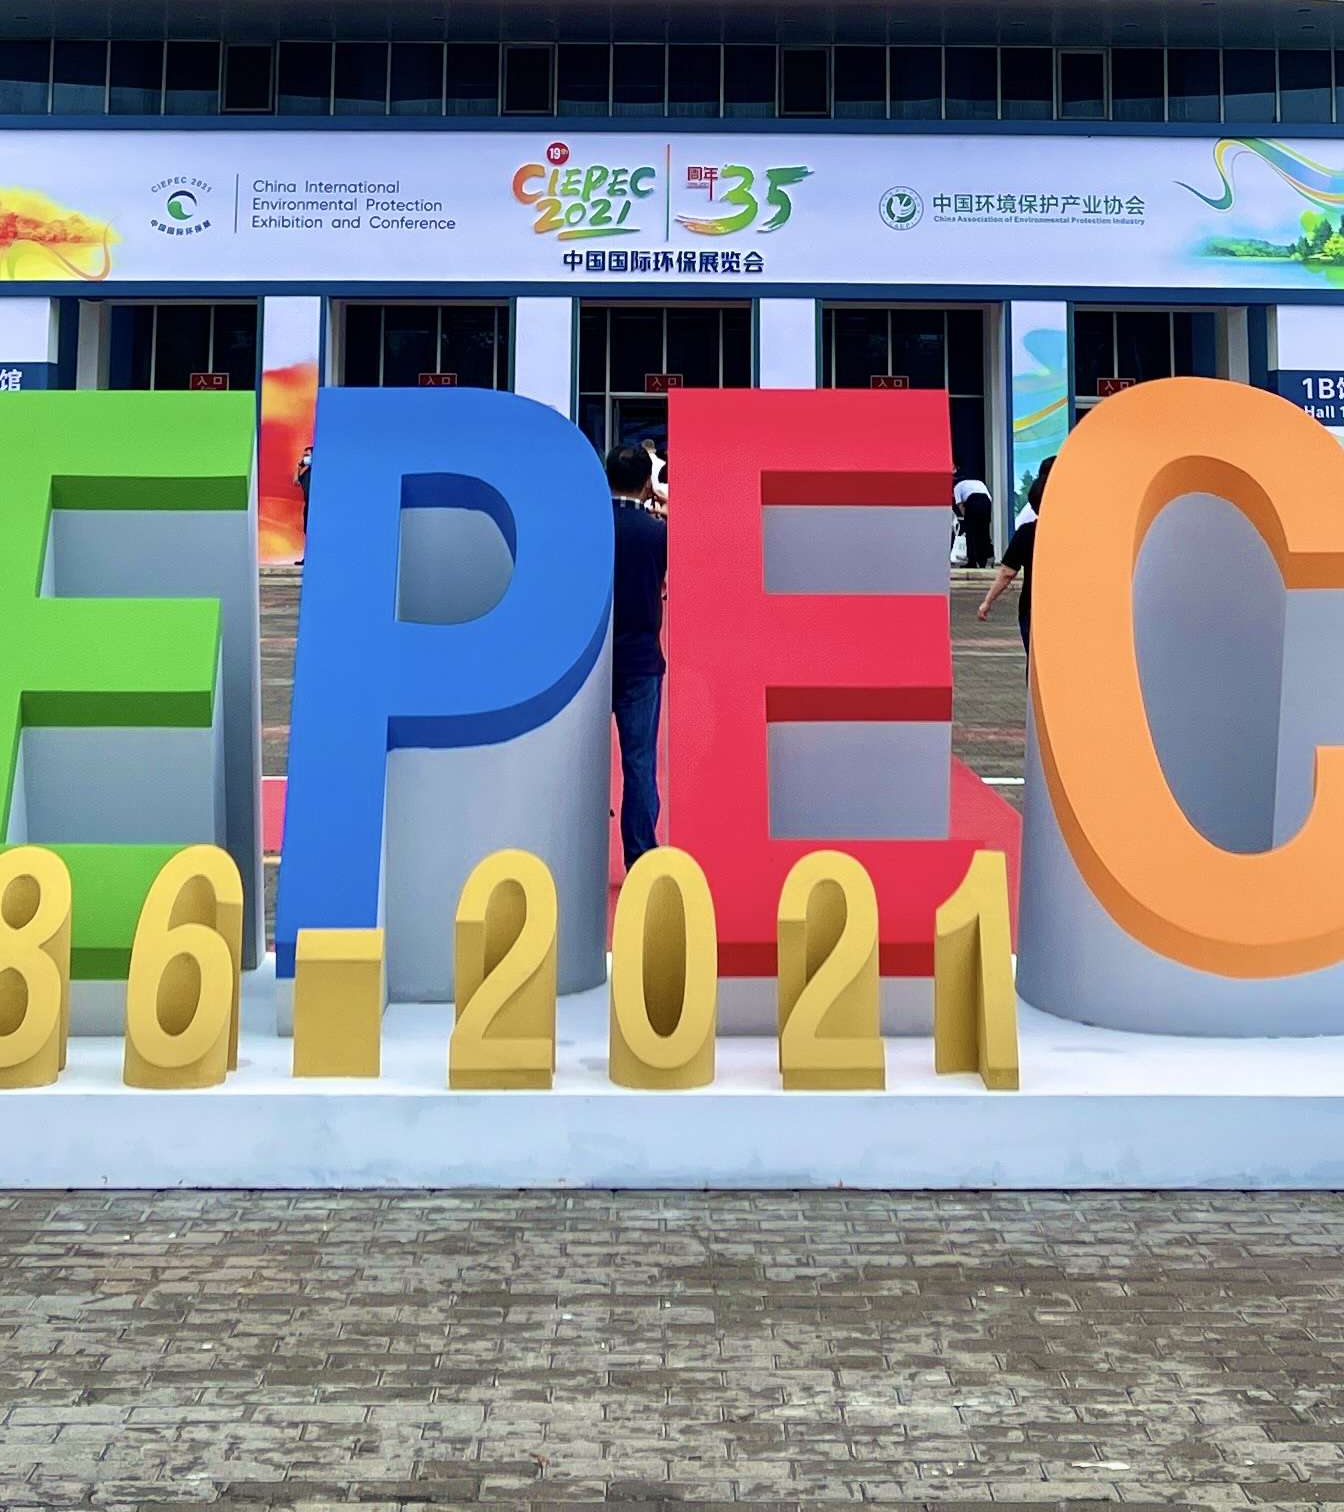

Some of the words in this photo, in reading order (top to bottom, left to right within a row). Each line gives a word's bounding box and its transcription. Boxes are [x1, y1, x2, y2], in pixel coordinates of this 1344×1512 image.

[151, 177, 187, 192] CIEPEC
[253, 179, 296, 193] China
[305, 180, 400, 194] International
[512, 164, 655, 204] CIEPEC
[253, 198, 357, 212] Environmental
[366, 198, 442, 212] Protection
[675, 165, 815, 235] 35
[933, 193, 1145, 216] 中国环境保护产业协会
[252, 215, 323, 229] Exhibition
[331, 216, 361, 229] and
[369, 216, 456, 230] Conference
[534, 198, 632, 233] 2021
[957, 215, 1004, 223] Association
[563, 250, 764, 273] 中国国际环保展览会
[197, 375, 223, 386] 入口
[427, 375, 451, 384] 入口
[651, 375, 677, 387] 入口
[877, 377, 903, 388] 入口
[1304, 405, 1335, 419] Hall
